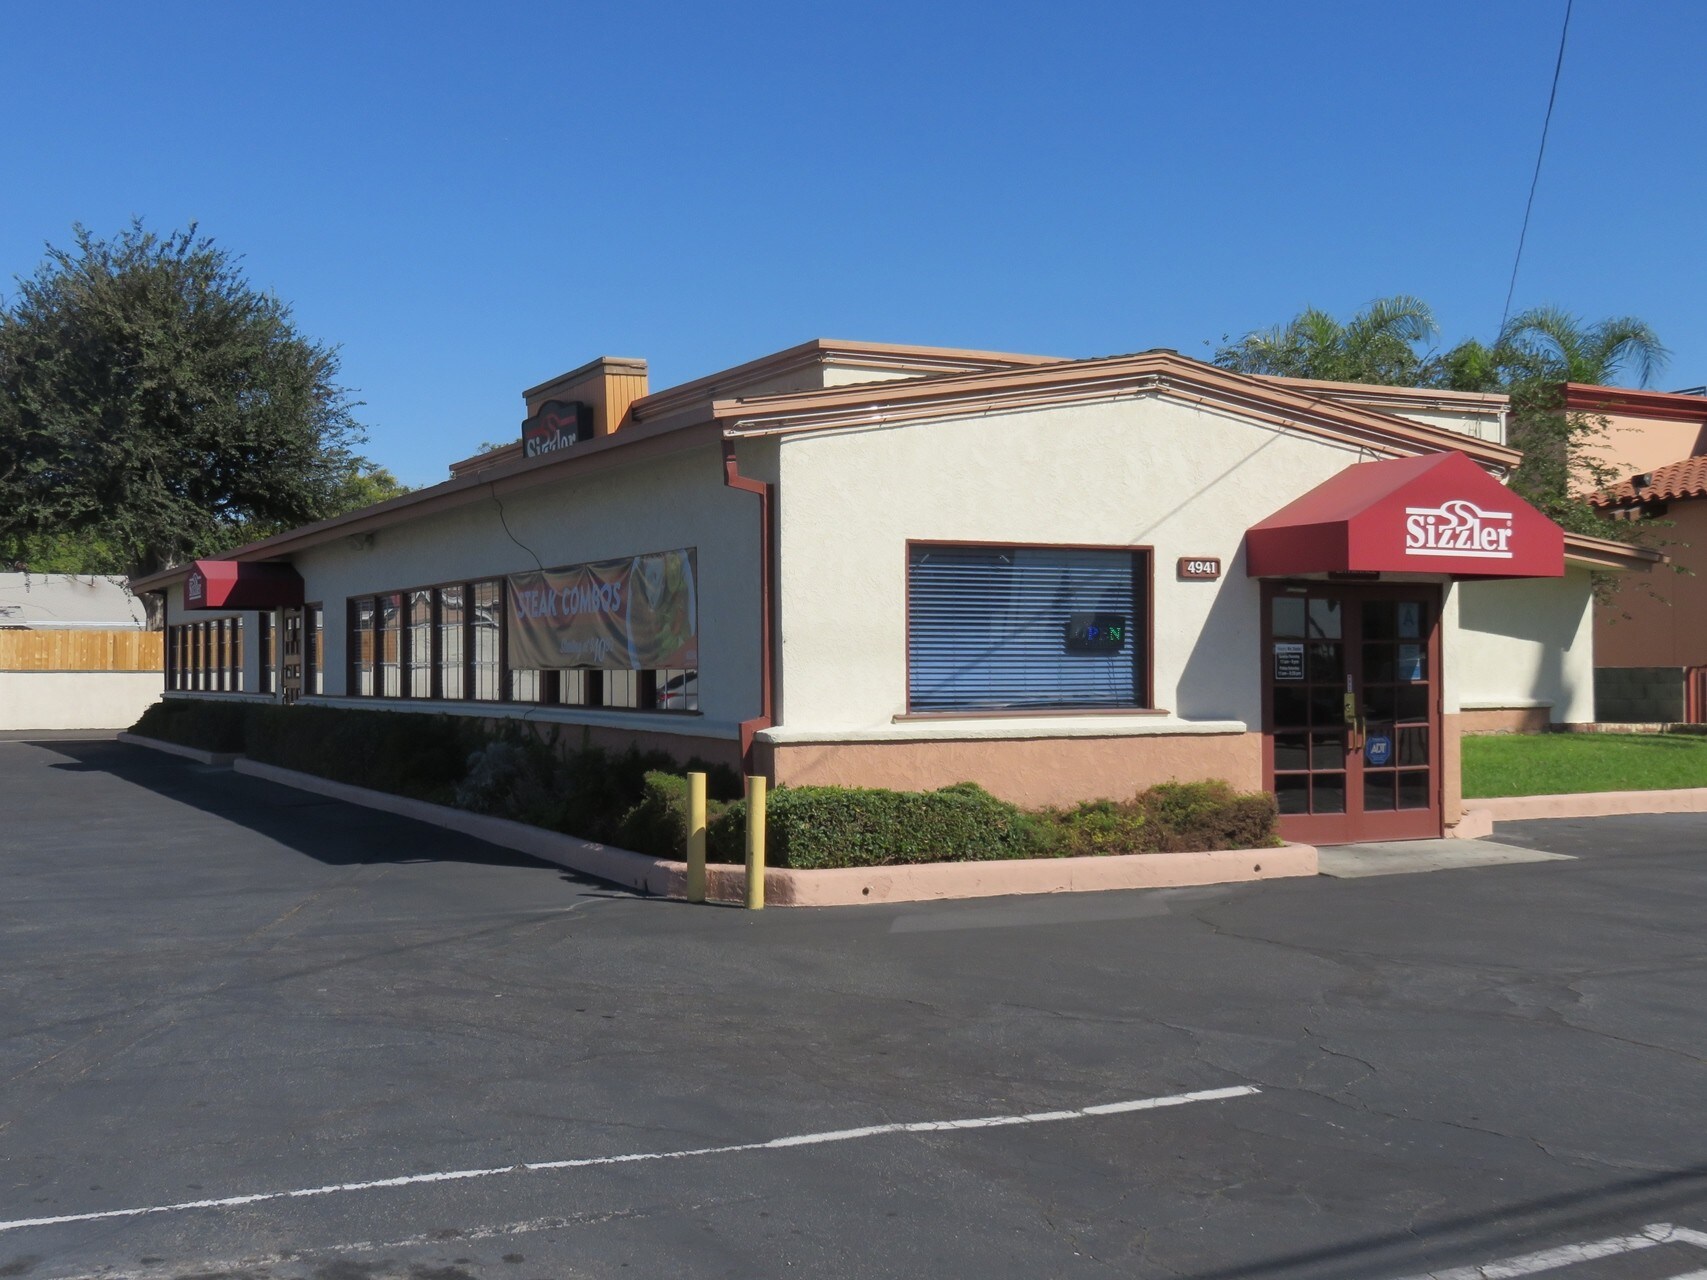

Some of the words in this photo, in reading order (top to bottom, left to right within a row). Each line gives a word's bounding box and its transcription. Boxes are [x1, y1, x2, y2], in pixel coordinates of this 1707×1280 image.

[1406, 501, 1512, 551] Sizzler
[1187, 561, 1216, 573] 4941
[517, 589, 557, 618] STEAK
[562, 582, 621, 615] COMBOS
[1370, 742, 1386, 753] ADT
